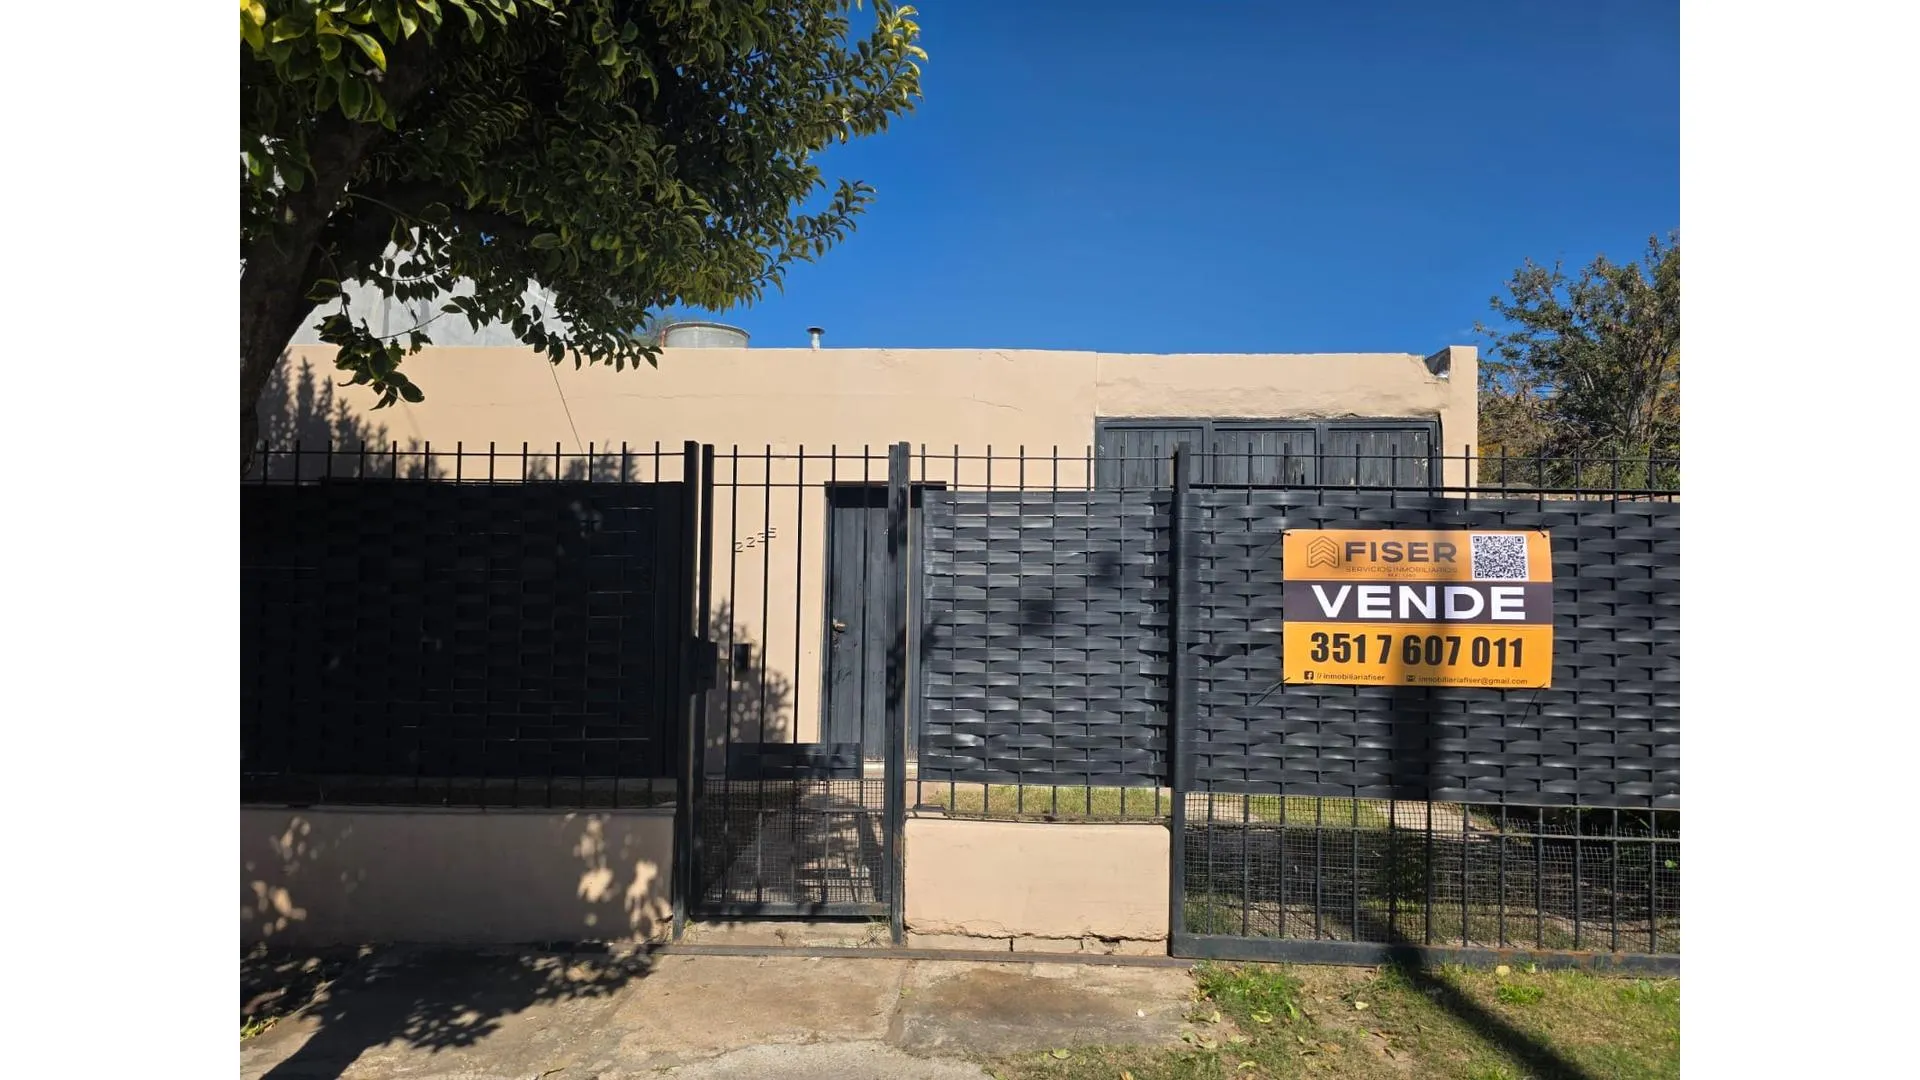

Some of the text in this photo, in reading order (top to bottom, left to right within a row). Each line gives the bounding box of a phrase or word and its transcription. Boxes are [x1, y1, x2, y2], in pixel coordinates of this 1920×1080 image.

[1345, 541, 1457, 563] FISER
[1346, 565, 1458, 574] SERVICIOS INMOBILIARIOS
[1311, 584, 1526, 620] VENDE
[1310, 632, 1523, 668] 351 7 607 011
[1419, 676, 1528, 686] inmobiliariafiser@gmail.com
